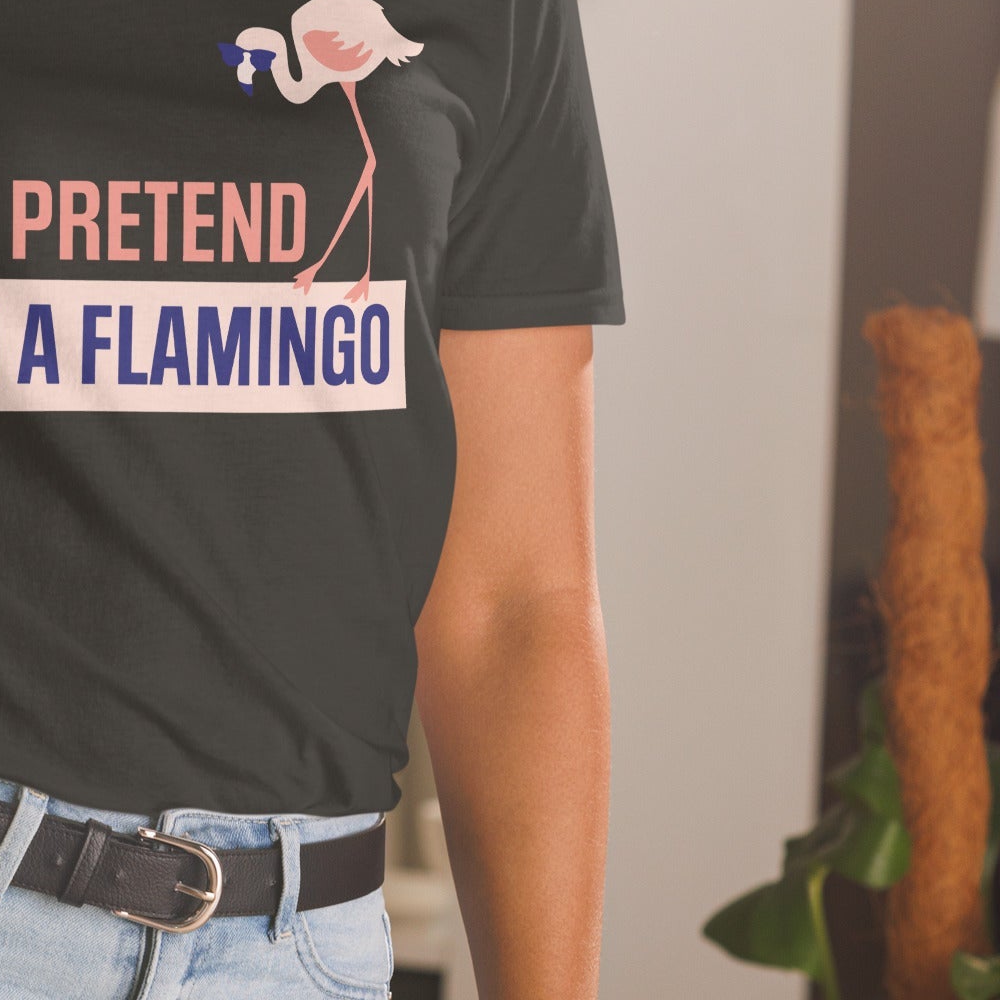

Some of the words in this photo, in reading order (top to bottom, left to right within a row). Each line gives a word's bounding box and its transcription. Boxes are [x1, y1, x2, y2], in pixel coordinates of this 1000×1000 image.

[12, 180, 306, 263] PRETEND
[17, 303, 60, 384] A
[81, 303, 390, 386] FLAMINGO
